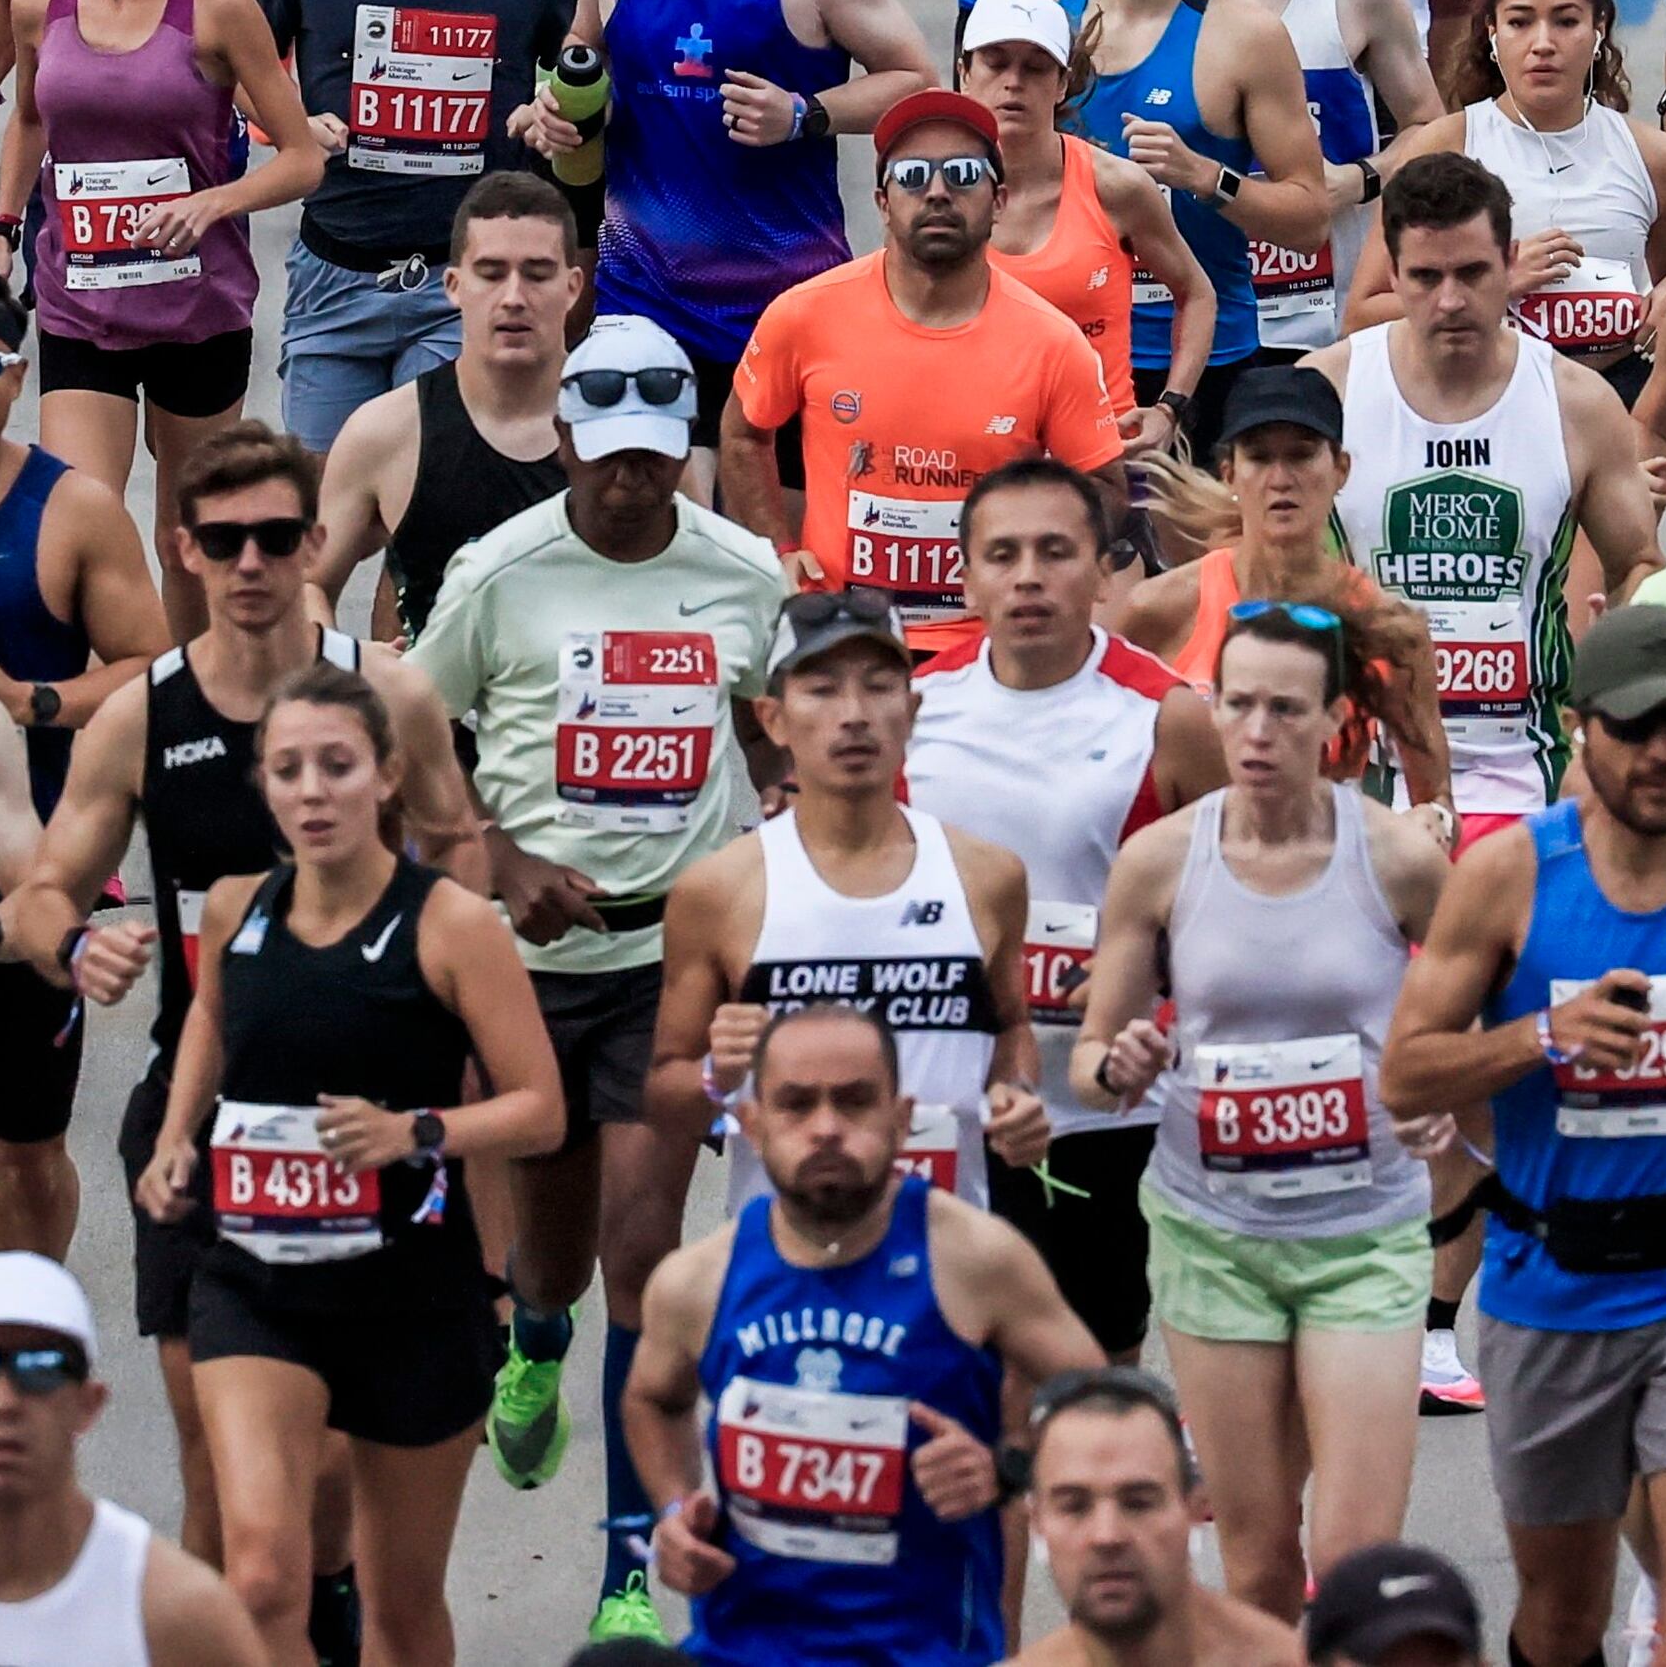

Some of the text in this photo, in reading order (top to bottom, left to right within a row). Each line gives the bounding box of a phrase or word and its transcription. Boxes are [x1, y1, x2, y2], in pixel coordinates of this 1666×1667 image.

[430, 25, 492, 50] 11177
[387, 65, 416, 75] Chicago
[387, 73, 423, 82] Marathon
[358, 90, 486, 135] B 11177
[73, 204, 171, 243] B 73
[1534, 299, 1633, 338] 10350
[895, 446, 956, 470] ROAD
[1425, 439, 1490, 468] JOHN
[896, 469, 982, 489] RUNNE
[1409, 492, 1501, 520] MERCY
[1410, 516, 1500, 540] HOME
[854, 536, 964, 584] B 1112
[1380, 553, 1524, 587] HEROES
[1411, 585, 1497, 598] HELPING KIDS
[650, 646, 705, 673] 2251
[164, 736, 225, 770] HOKA
[575, 732, 694, 778] B 2251
[771, 962, 964, 996] LONE WOLF
[886, 995, 969, 1026] CLUB
[1216, 1089, 1348, 1143] B 3393
[232, 1157, 360, 1208] B 4313
[736, 1307, 907, 1356] MILLROSE
[738, 1440, 884, 1502] B 7347
